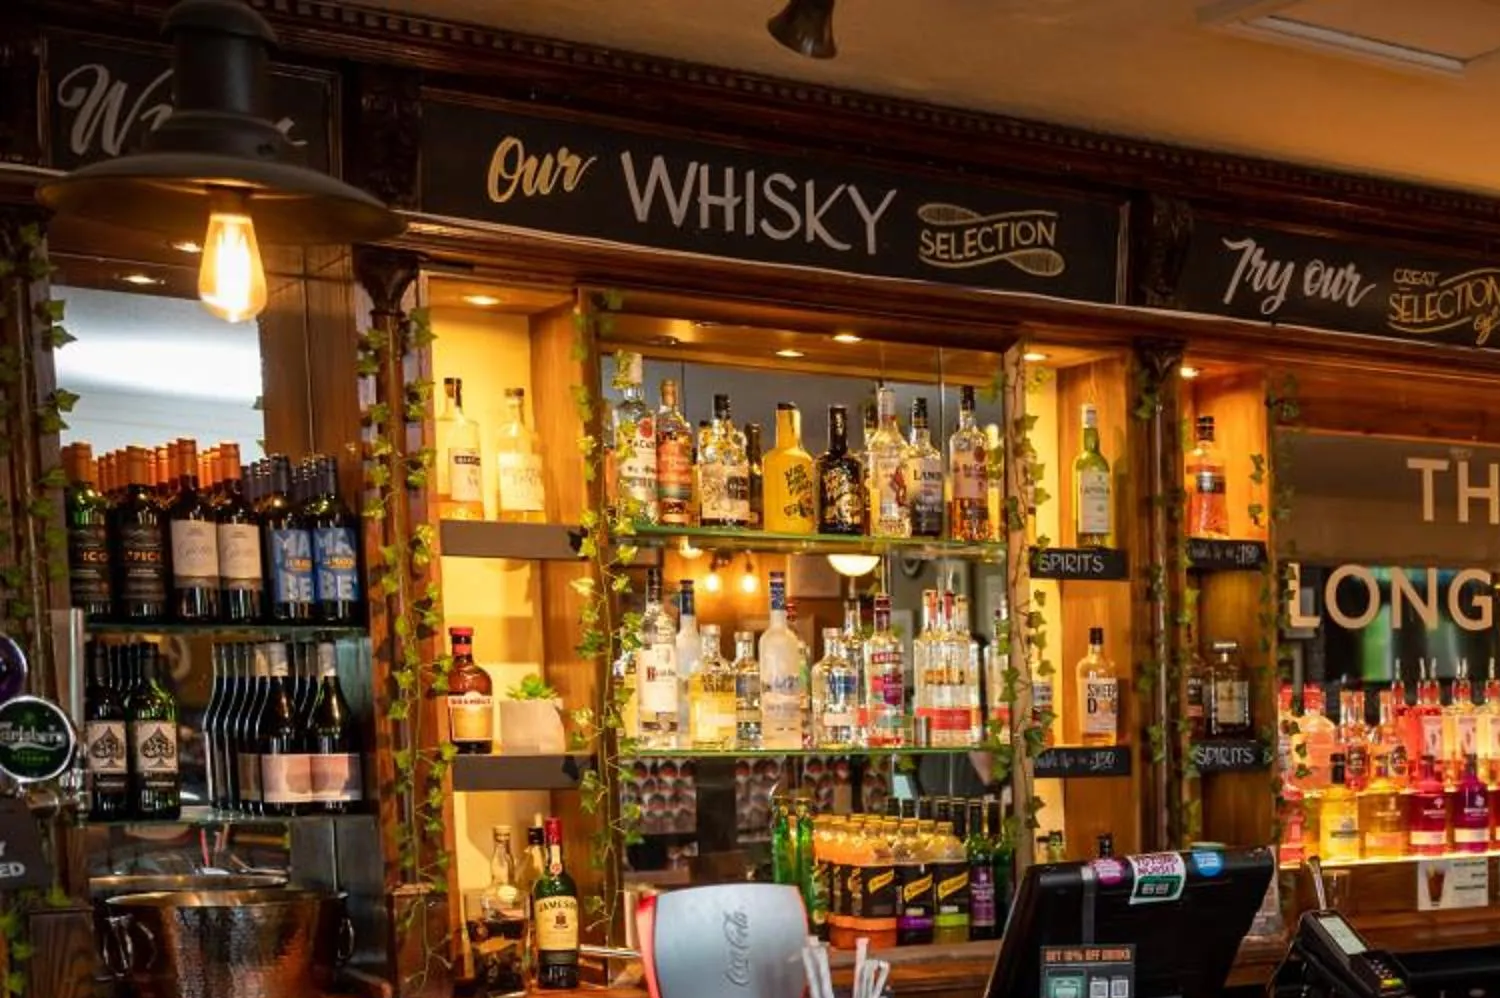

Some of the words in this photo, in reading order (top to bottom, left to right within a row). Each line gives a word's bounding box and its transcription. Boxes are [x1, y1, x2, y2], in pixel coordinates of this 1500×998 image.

[487, 136, 597, 202] Our
[621, 150, 897, 255] WHISKY
[920, 220, 1057, 259] SELECTION
[1223, 238, 1293, 314] Try
[1303, 259, 1376, 308] our
[1038, 552, 1105, 574] SPIRITS
